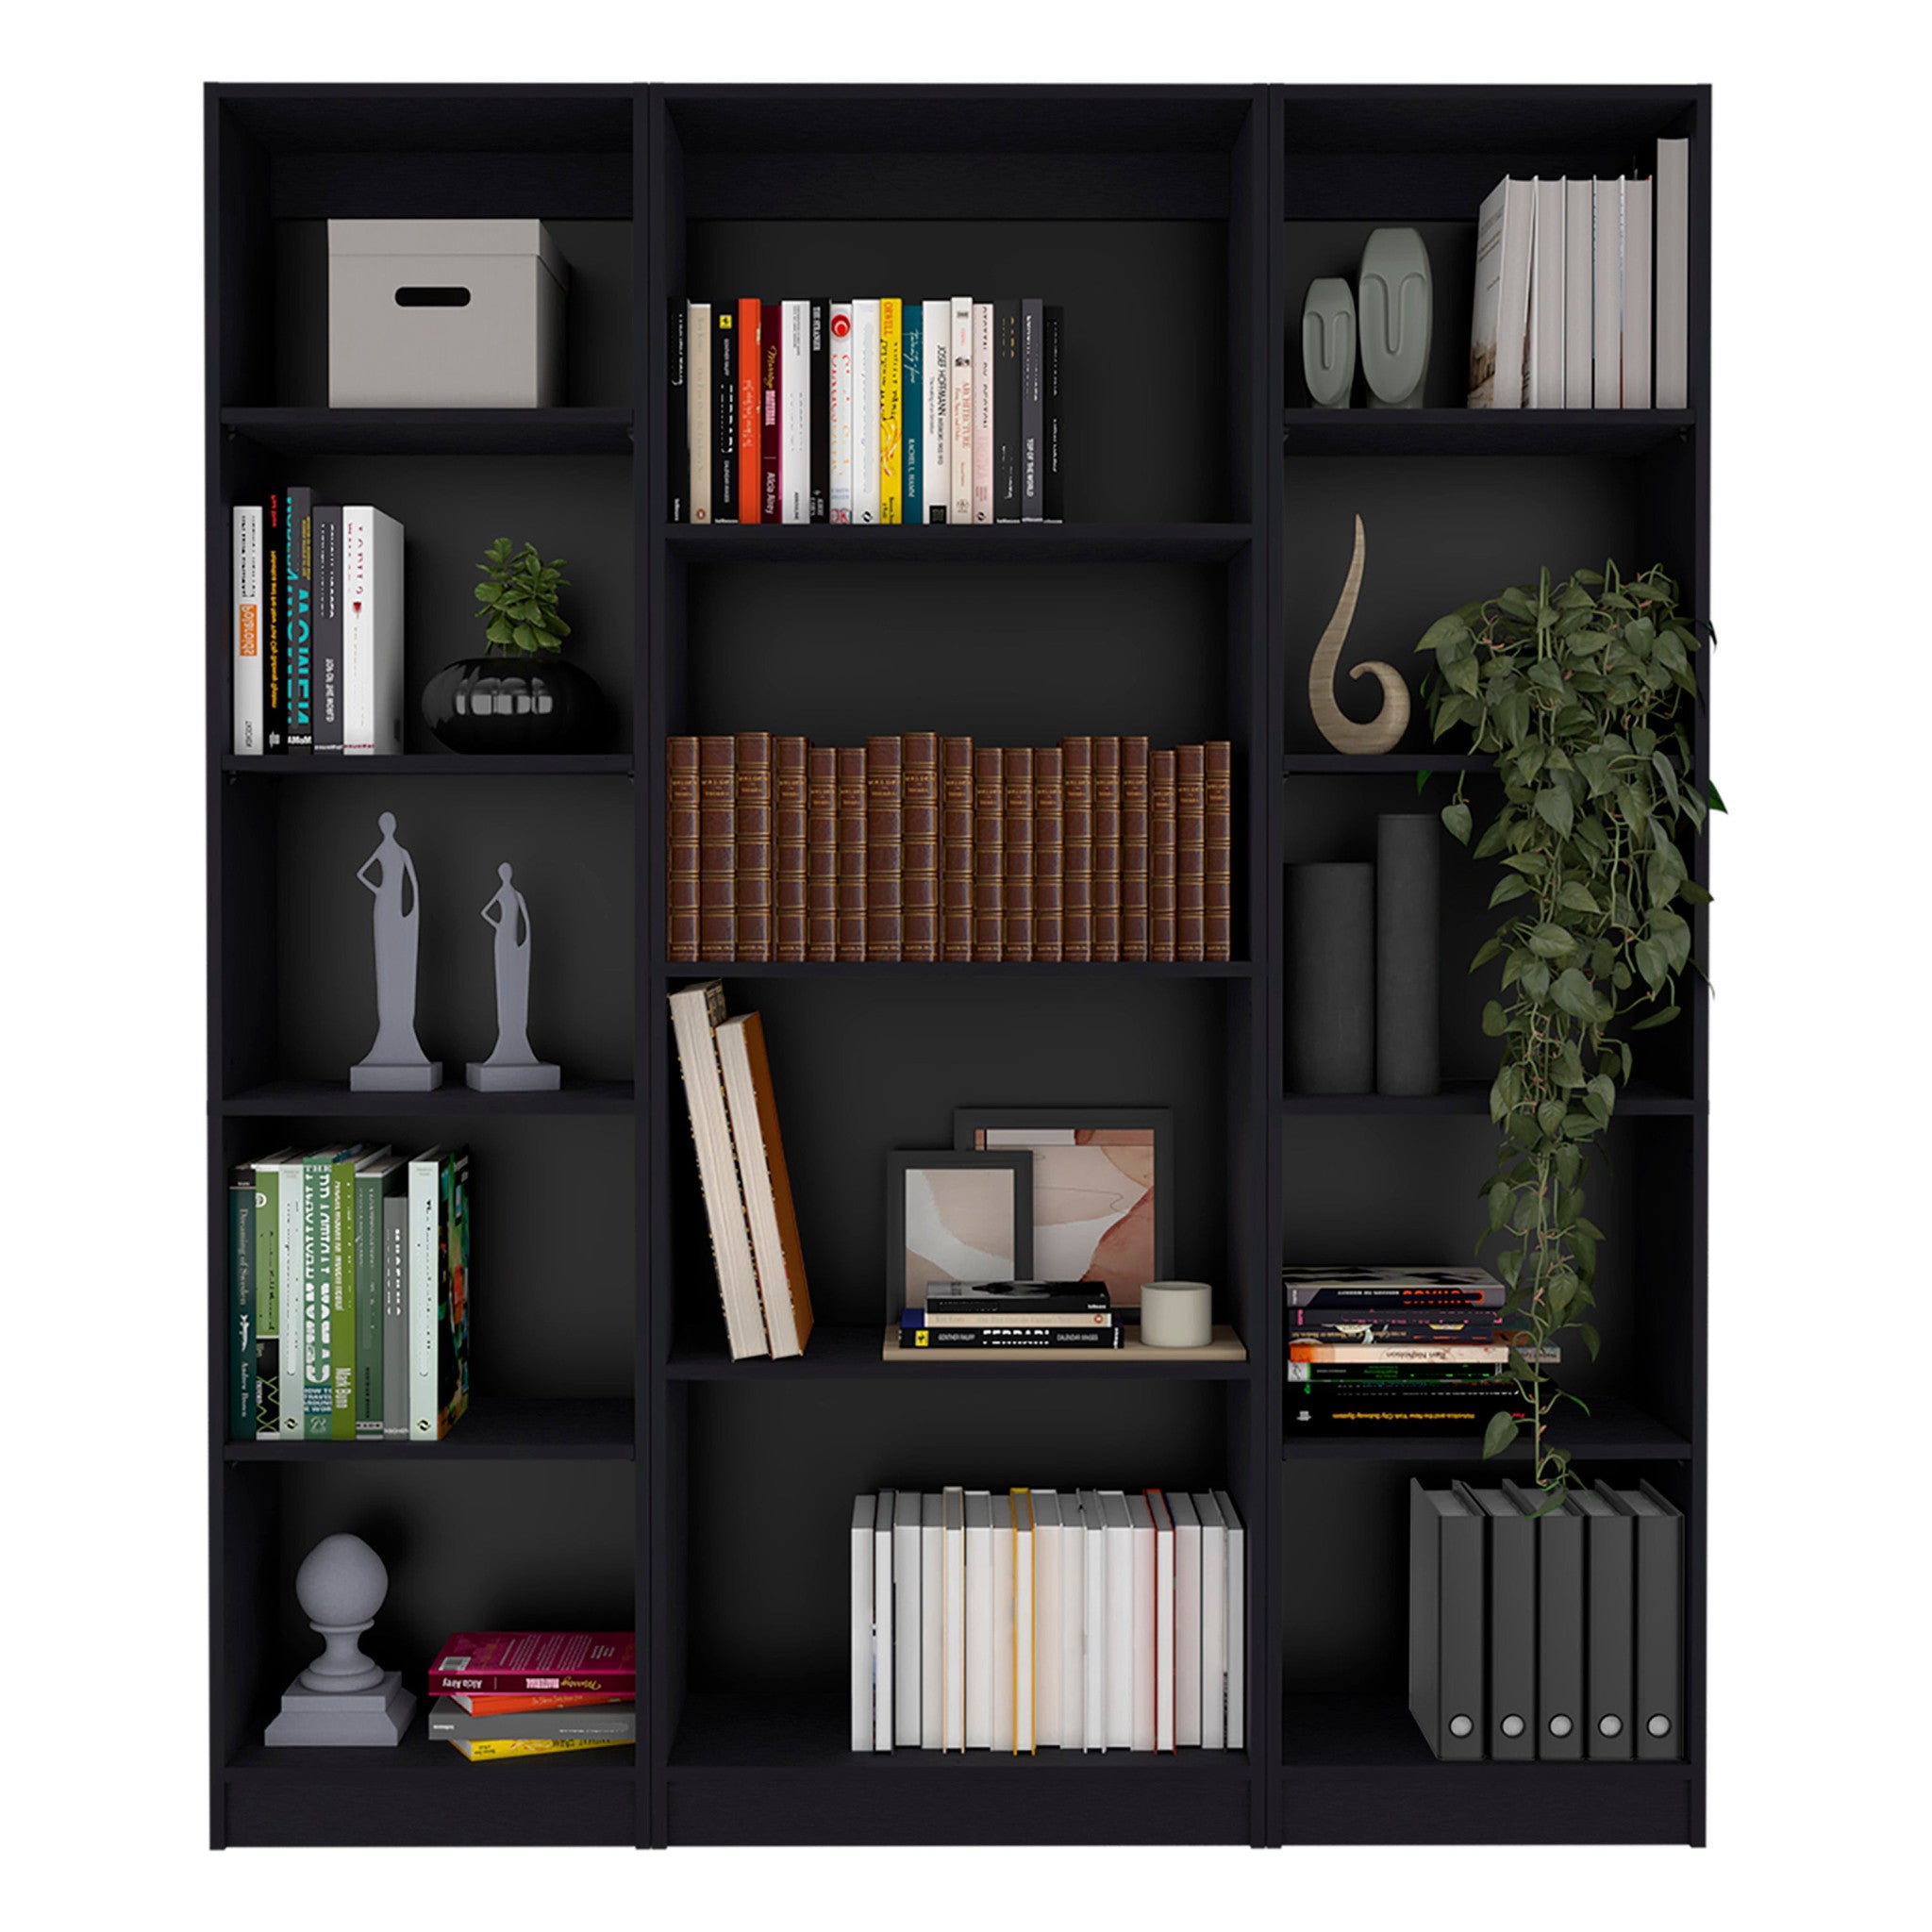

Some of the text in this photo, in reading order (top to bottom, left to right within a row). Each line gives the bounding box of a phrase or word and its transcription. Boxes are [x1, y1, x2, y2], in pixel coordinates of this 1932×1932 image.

[938, 345, 947, 368] JOSEF
[938, 370, 947, 416] HOFFMANN
[1026, 451, 1034, 460] OF
[238, 1208, 249, 1305] Dreaming of Sweden
[335, 1368, 351, 1387] Mark
